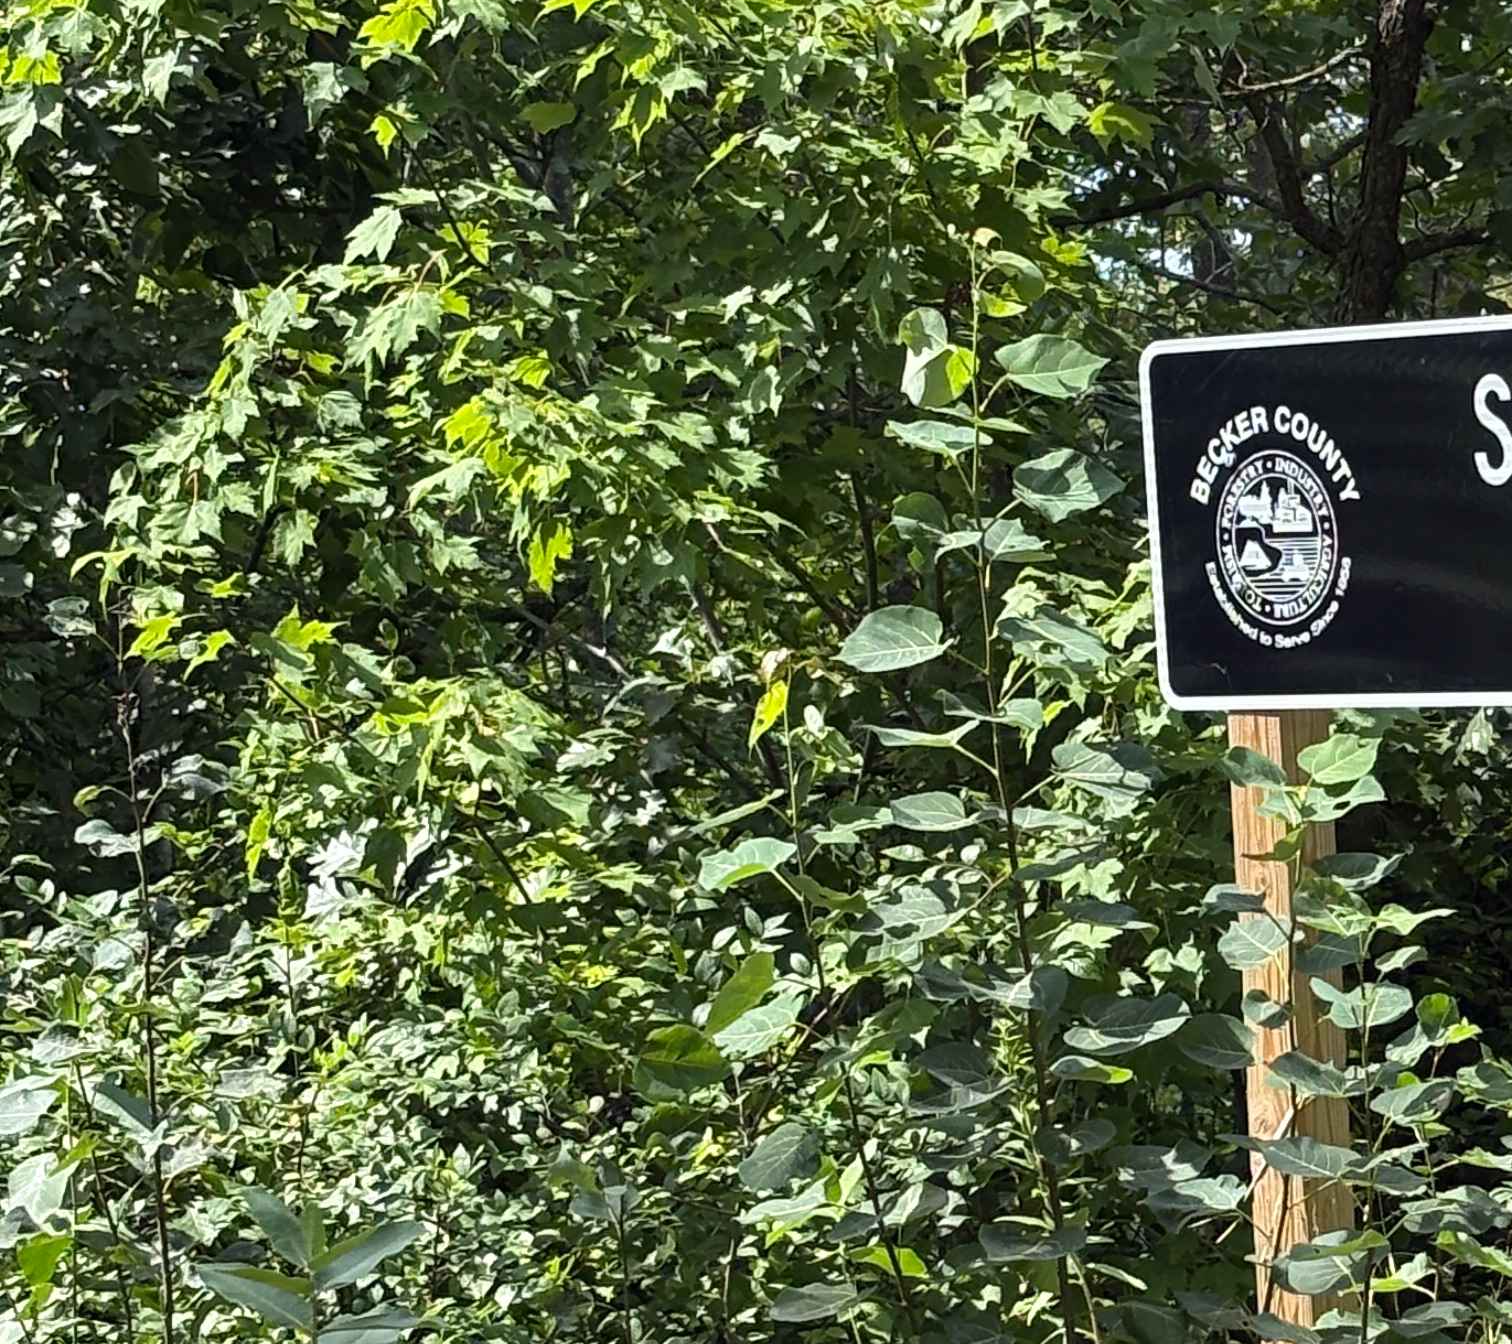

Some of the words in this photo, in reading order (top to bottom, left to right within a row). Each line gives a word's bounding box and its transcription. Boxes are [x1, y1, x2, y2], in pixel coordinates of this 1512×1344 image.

[1189, 405, 1269, 505] BECKER
[1273, 404, 1362, 503] COUNTY
[1221, 458, 1264, 534] FORESTRY
[1274, 457, 1330, 523] INDUSTRY
[1259, 631, 1273, 647] to
[1274, 630, 1311, 650] Serve
